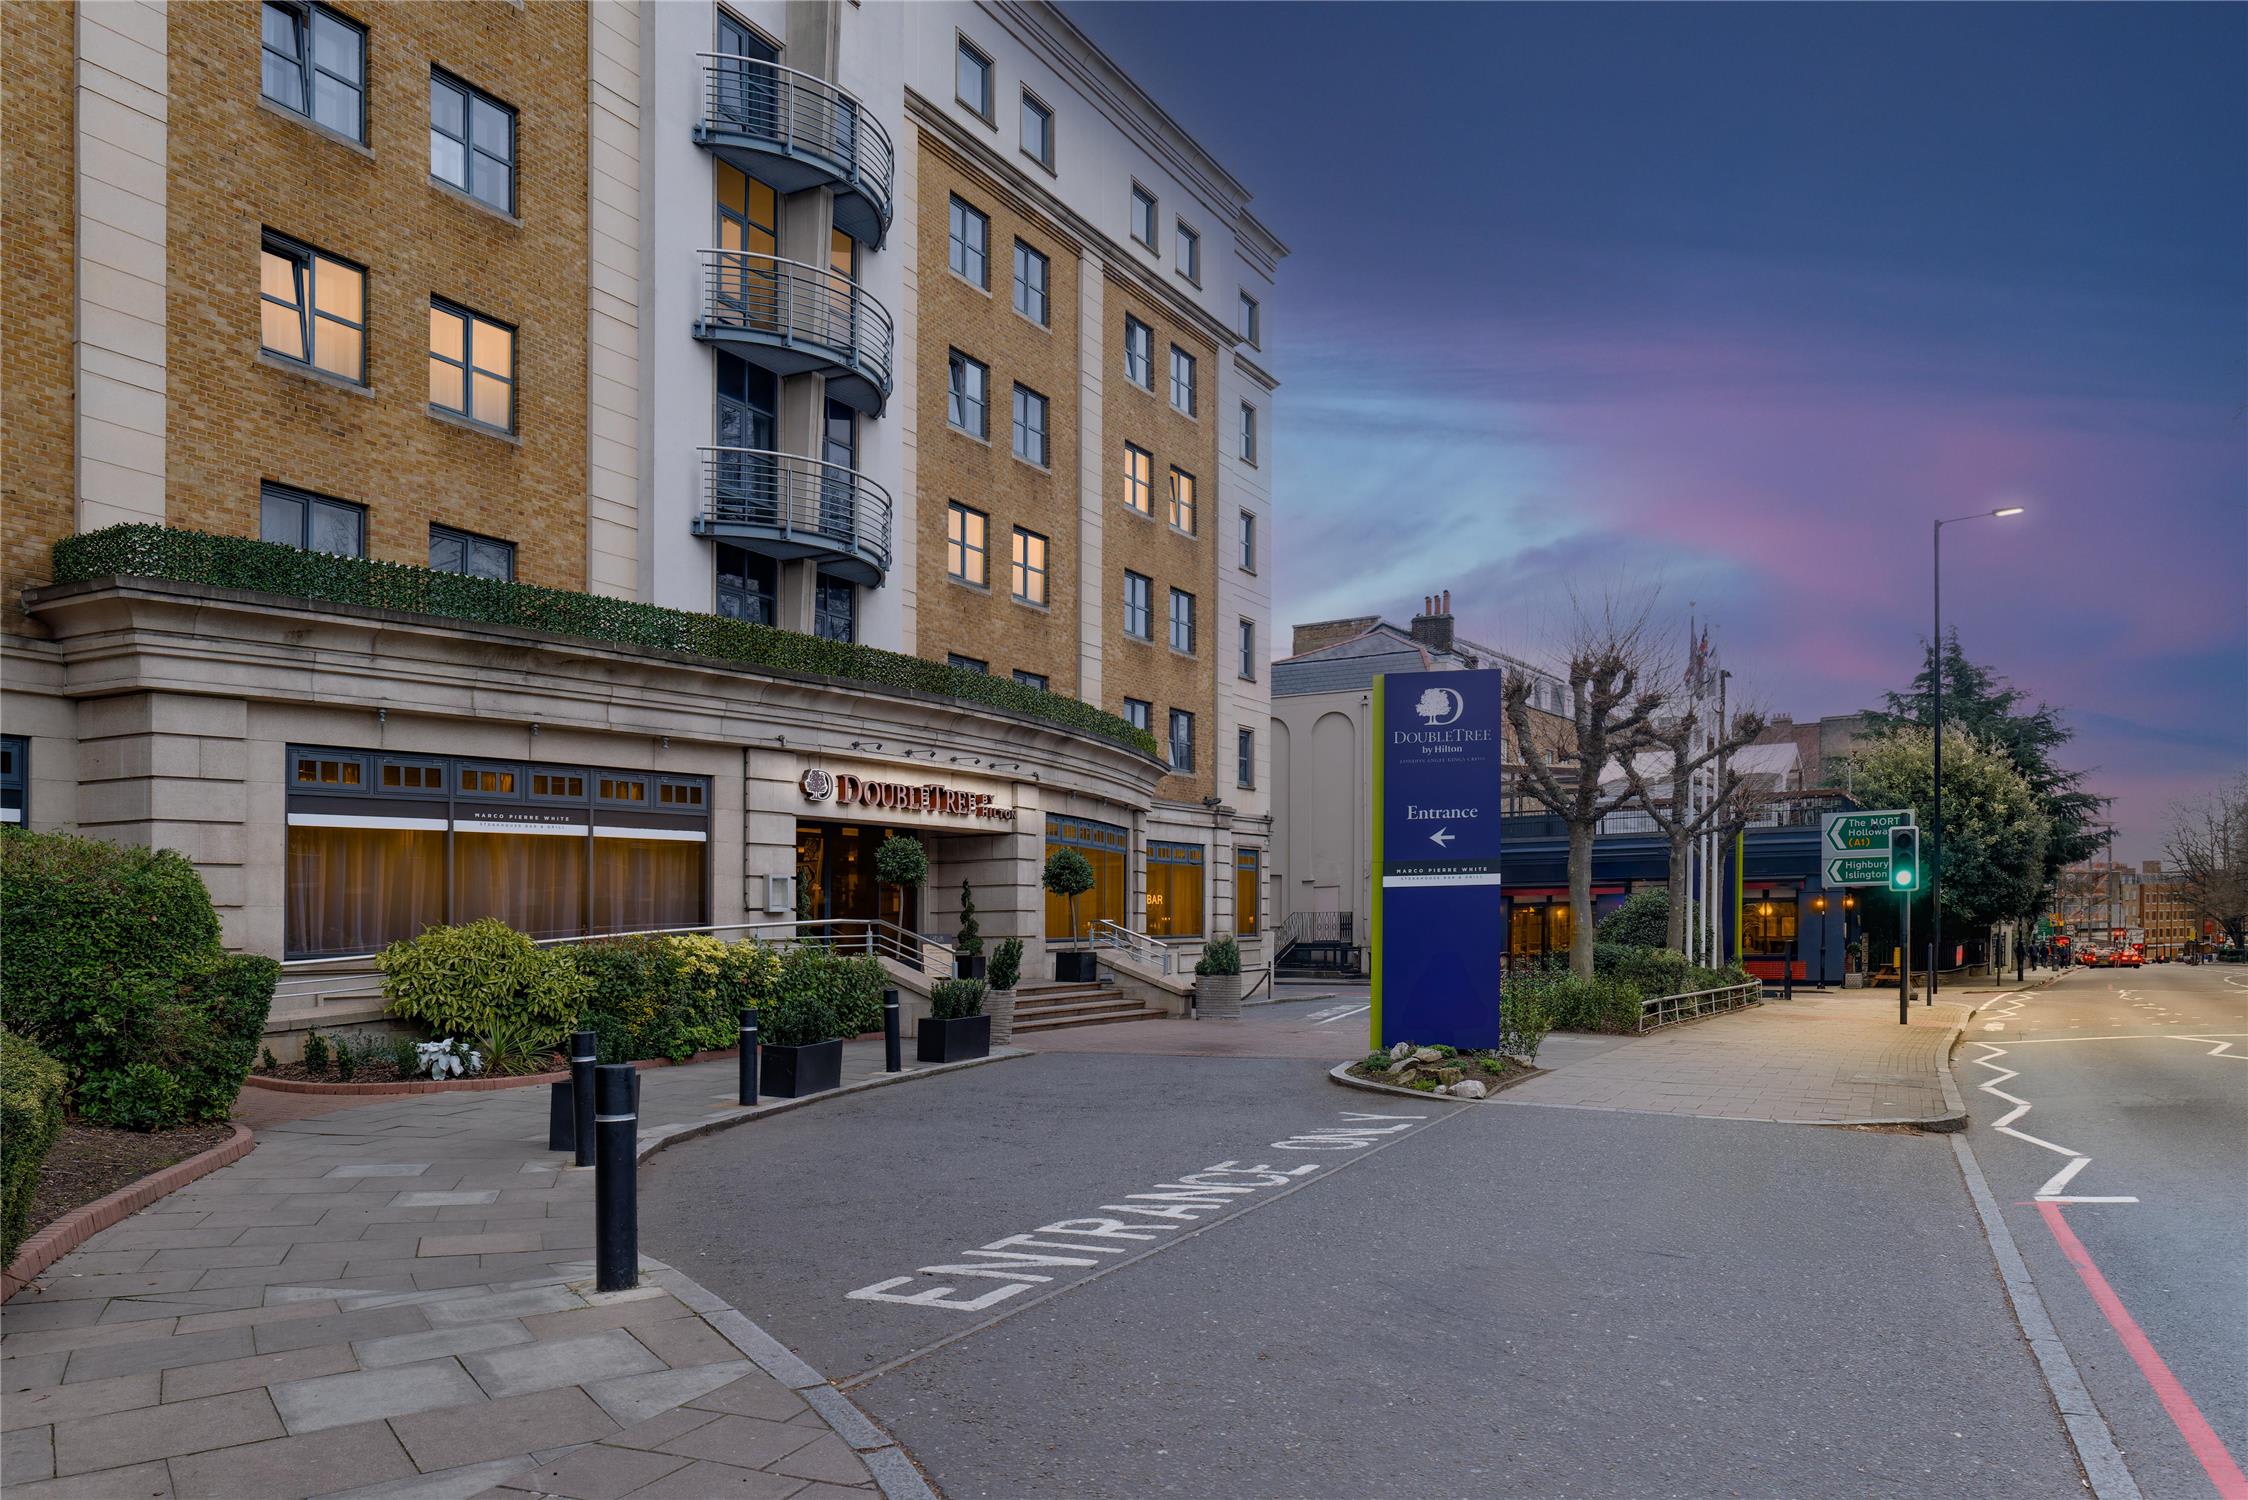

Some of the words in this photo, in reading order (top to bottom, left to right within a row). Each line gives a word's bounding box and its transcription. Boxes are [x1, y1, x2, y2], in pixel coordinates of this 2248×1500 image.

[1422, 745, 1433, 756] by
[1434, 744, 1463, 754] Hilton
[982, 806, 1017, 820] HILTON
[1407, 805, 1478, 820] Entrance
[1848, 819, 1866, 827] The
[1870, 817, 1901, 826] NORT
[1848, 828, 1888, 836] Hollowa
[1848, 837, 1871, 848] (A1)
[1845, 860, 1889, 870] Highbury
[1845, 870, 1888, 880] Islington
[1146, 894, 1163, 905] BAR
[845, 1160, 1320, 1312] ENTRANCE
[1270, 1111, 1428, 1150] ONLY
